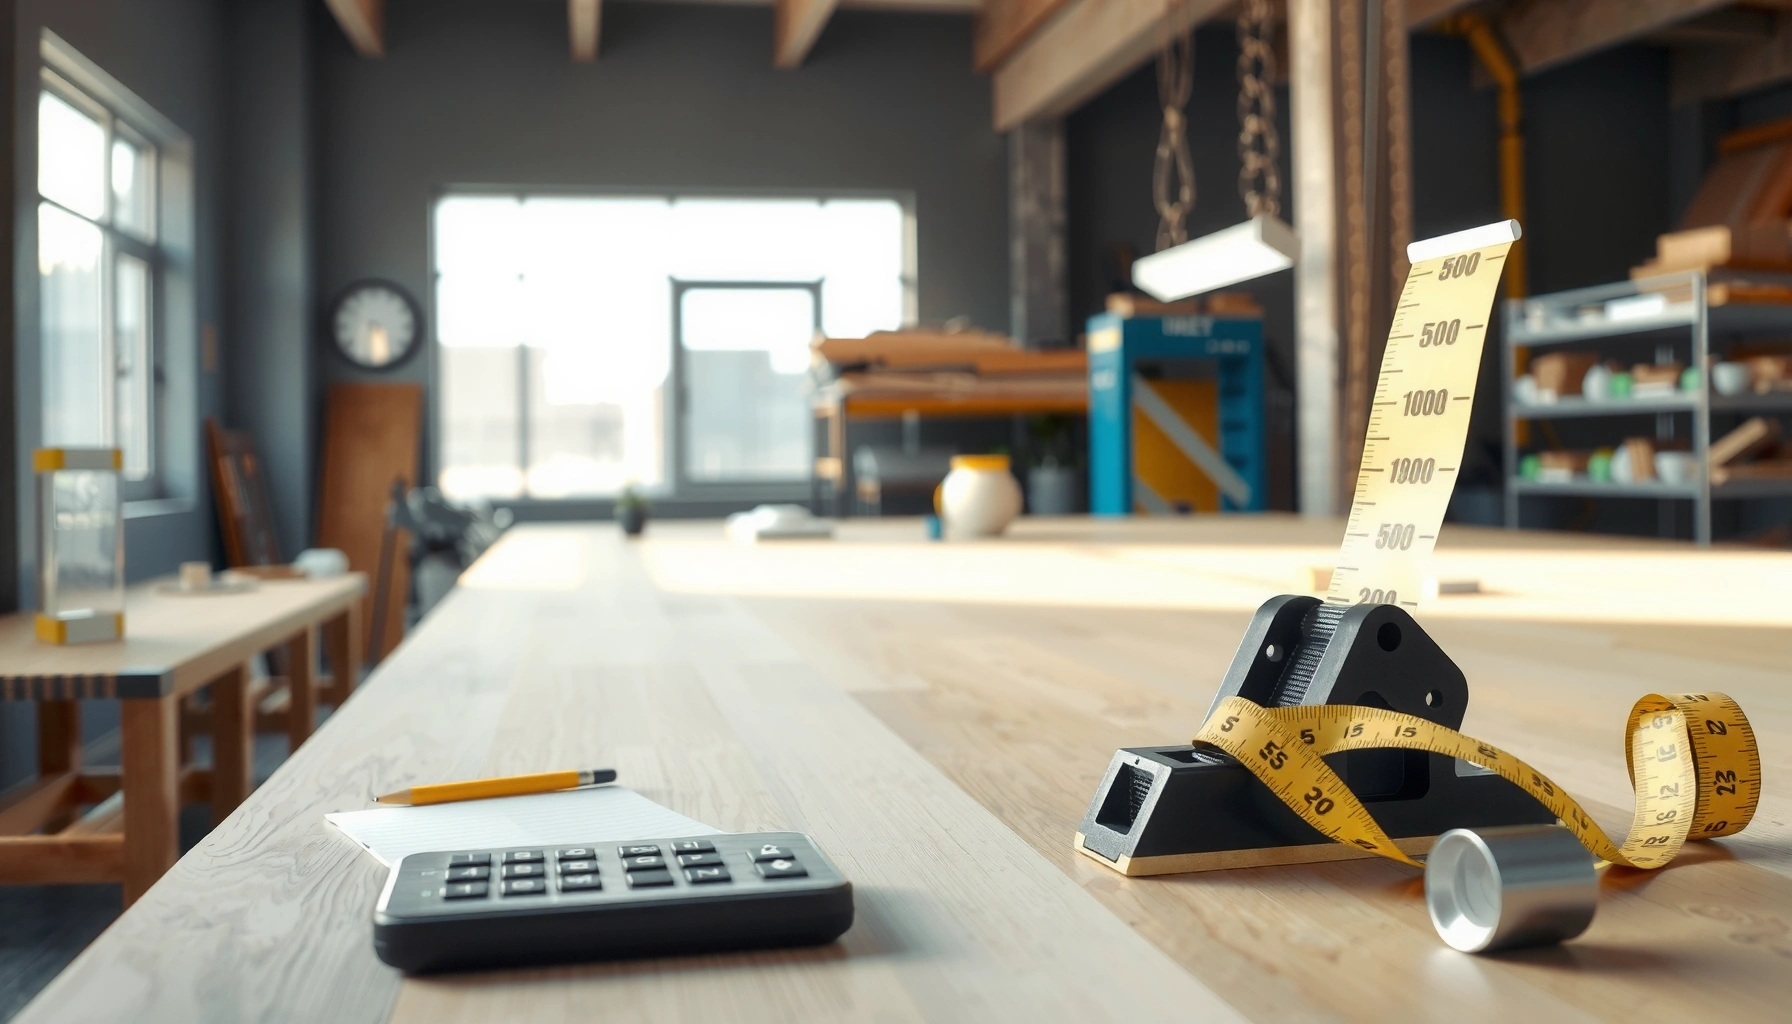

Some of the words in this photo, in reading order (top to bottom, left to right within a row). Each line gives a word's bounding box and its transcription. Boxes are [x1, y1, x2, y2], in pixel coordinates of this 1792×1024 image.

[1438, 252, 1481, 281] 500
[1419, 318, 1461, 348] 500
[1403, 388, 1448, 417] 1000
[1375, 523, 1416, 551] 500
[1300, 729, 1315, 744] 5
[1394, 726, 1418, 738] 15
[1716, 770, 1737, 796] 23
[1303, 786, 1335, 815] 20
